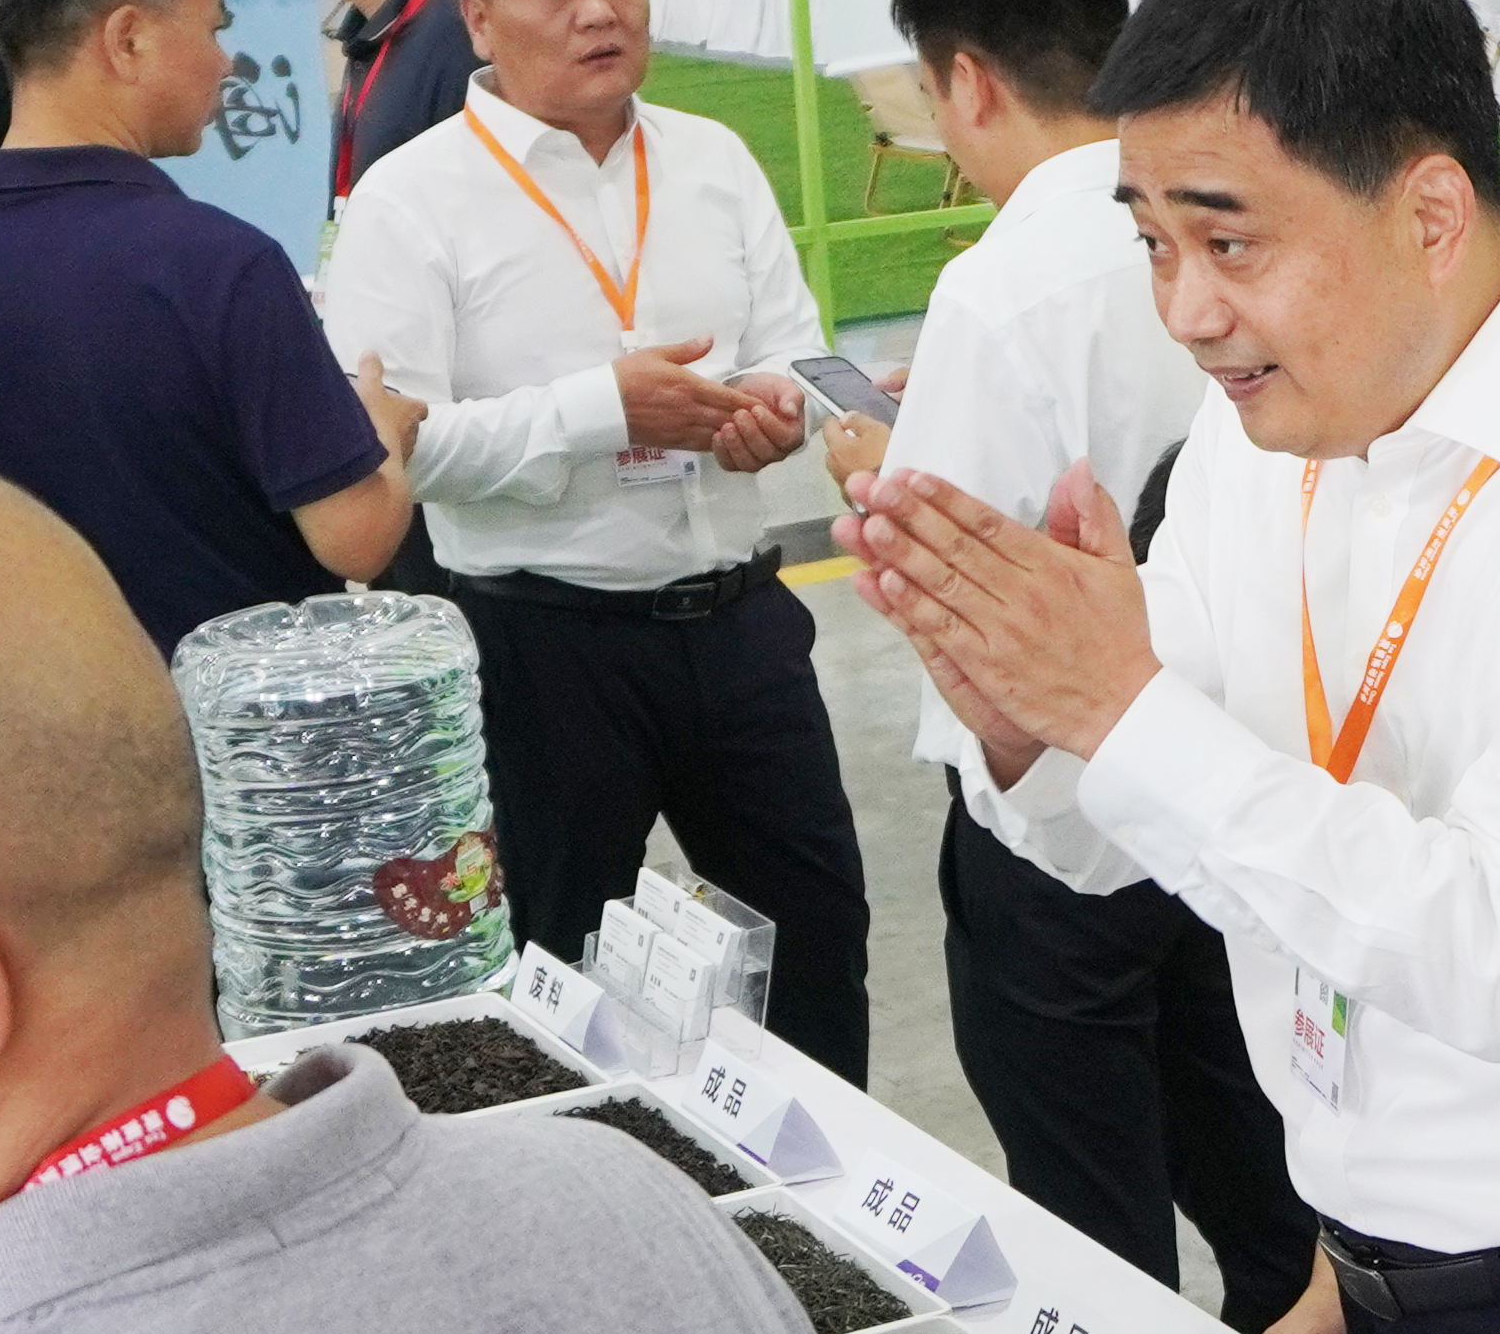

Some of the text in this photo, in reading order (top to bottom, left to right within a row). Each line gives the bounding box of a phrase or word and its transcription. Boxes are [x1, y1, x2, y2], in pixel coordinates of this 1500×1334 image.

[616, 446, 667, 467] 参展证
[527, 961, 565, 1016] 废料
[1294, 1008, 1326, 1059] 参展证
[701, 1063, 749, 1120] 成品
[861, 1176, 921, 1235] 成品
